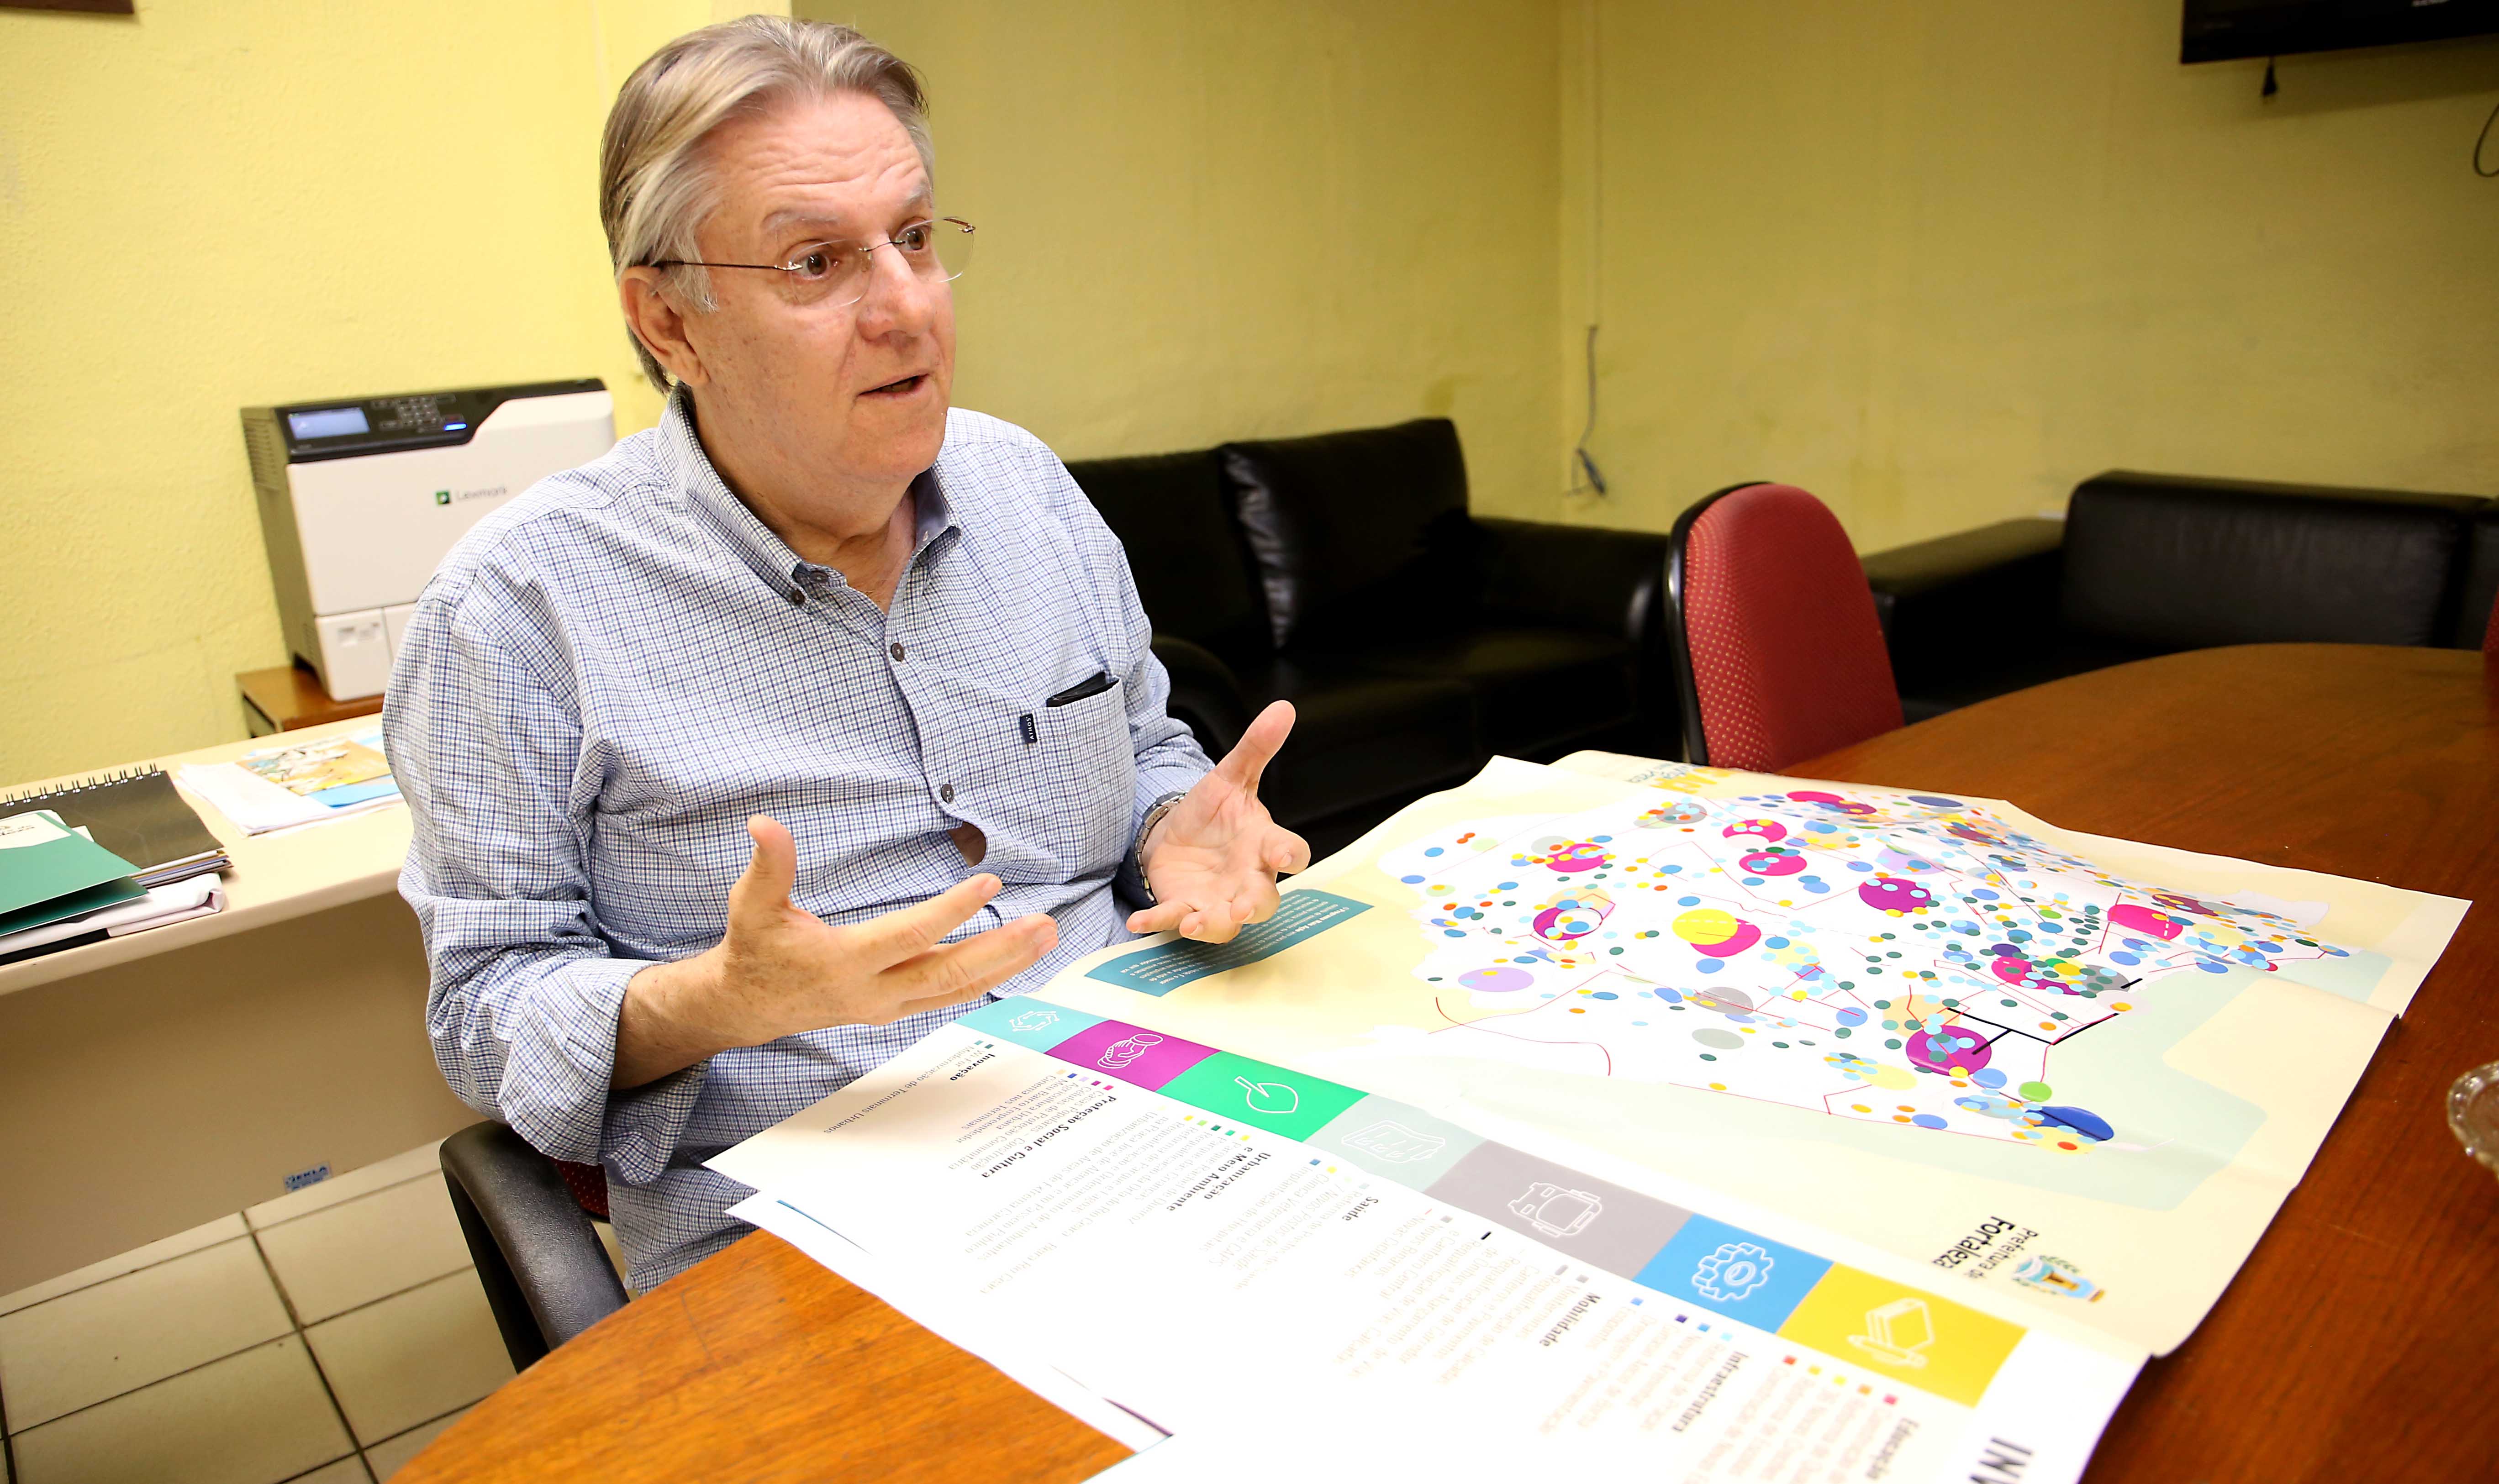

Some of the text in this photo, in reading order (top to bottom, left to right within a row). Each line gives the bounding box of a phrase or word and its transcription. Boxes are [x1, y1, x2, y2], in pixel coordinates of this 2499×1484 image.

[455, 485, 507, 504] Lexmark
[947, 1053, 996, 1082] Inovação
[822, 1045, 974, 1135] Modernização de Terminais Urbanos
[960, 1074, 1057, 1130] Cinema nos Terminais
[954, 1079, 1068, 1144] Meu Bairro Empreendedor
[995, 1082, 1079, 1131] Agricultura Urbana
[1065, 1095, 1117, 1125] Proteção
[1154, 1116, 1170, 1125] na
[946, 1085, 1093, 1170] Células de Proteção Comunitária
[966, 1090, 1105, 1171] Casas Populares Construção
[1031, 1124, 1071, 1147] Social
[1099, 1111, 1158, 1148] Urbanização
[1127, 1125, 1160, 1143] Praça
[1155, 1126, 1199, 1154] Reforma
[1087, 1147, 1106, 1156] de
[1107, 1142, 1133, 1157] José
[1116, 1121, 1185, 1166] Requalificação
[1143, 1152, 1162, 1163] de
[1146, 1131, 1213, 1176] Requalificação
[979, 1151, 1027, 1179] Cultura
[1095, 1156, 1113, 1166] de
[1132, 1136, 1228, 1202] Parque das Crianças
[1216, 1152, 1248, 1173] Meio
[1047, 1173, 1066, 1183] de
[1060, 1165, 1102, 1189] Alencar
[1125, 1141, 1242, 1225] Parque Rachel de Queiroz
[1135, 1174, 1154, 1184] da
[1201, 1152, 1272, 1201] Urbanização
[1008, 1181, 1054, 1209] Extrema
[1039, 1194, 1056, 1203] no
[1047, 1171, 1115, 1214] Ordenamento
[1104, 1197, 1123, 1207] do
[1116, 1183, 1143, 1199] Orla
[1165, 1172, 1222, 1212] Ambiente
[1303, 1189, 1340, 1212] Novos
[964, 1207, 1015, 1238] Carência
[1034, 1212, 1054, 1223] de
[1196, 1165, 1314, 1253] Implantação de Hospitais
[1340, 1195, 1380, 1223] Saúde
[1274, 1210, 1314, 1237] Postos
[1391, 1214, 1428, 1239] Novas
[1408, 1221, 1445, 1247] Novos
[1205, 1242, 1243, 1268] CAPS
[1260, 1234, 1283, 1248] de
[1410, 1235, 1458, 1271] Canteiro
[1932, 1216, 2016, 1268] Fortaleza
[1978, 1227, 2040, 1270] Prefeitura
[1376, 1268, 1421, 1300] Central
[1536, 1291, 1603, 1348] Mobilidade
[1670, 1350, 1750, 1433] Infraestrutura
